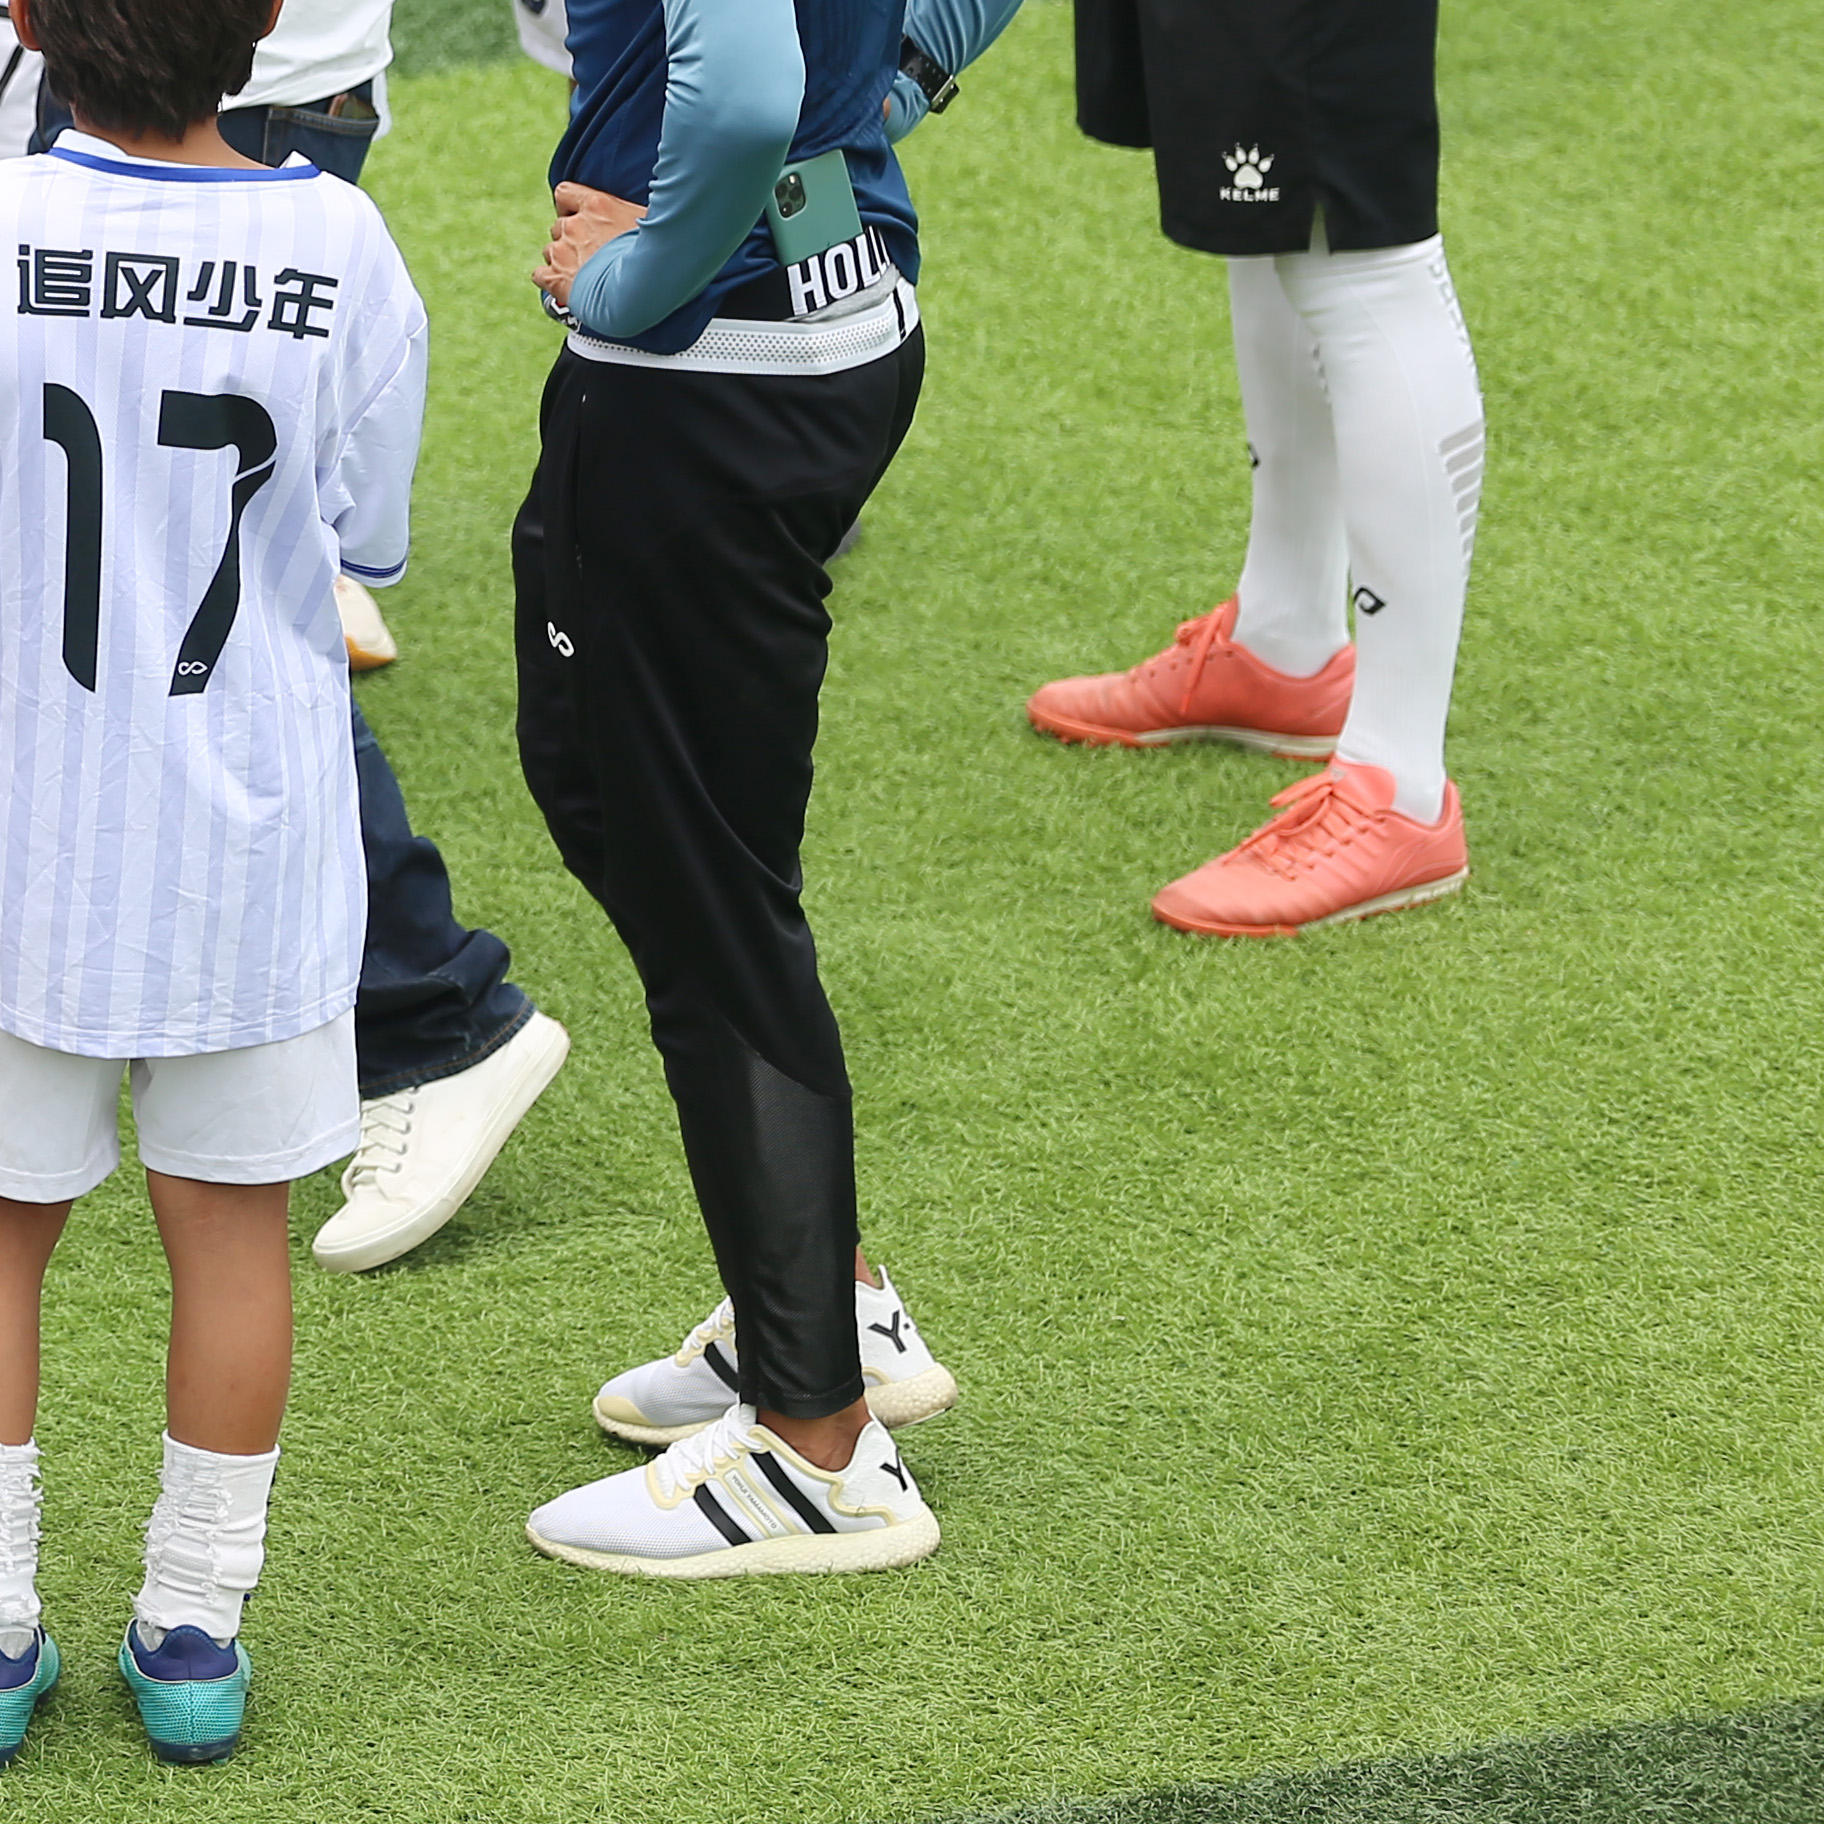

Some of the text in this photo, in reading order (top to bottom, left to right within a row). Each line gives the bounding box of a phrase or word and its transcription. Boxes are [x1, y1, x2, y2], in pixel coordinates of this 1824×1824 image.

[1219, 186, 1281, 203] KELME
[17, 243, 339, 341] 追风少年
[42, 382, 277, 695] 17
